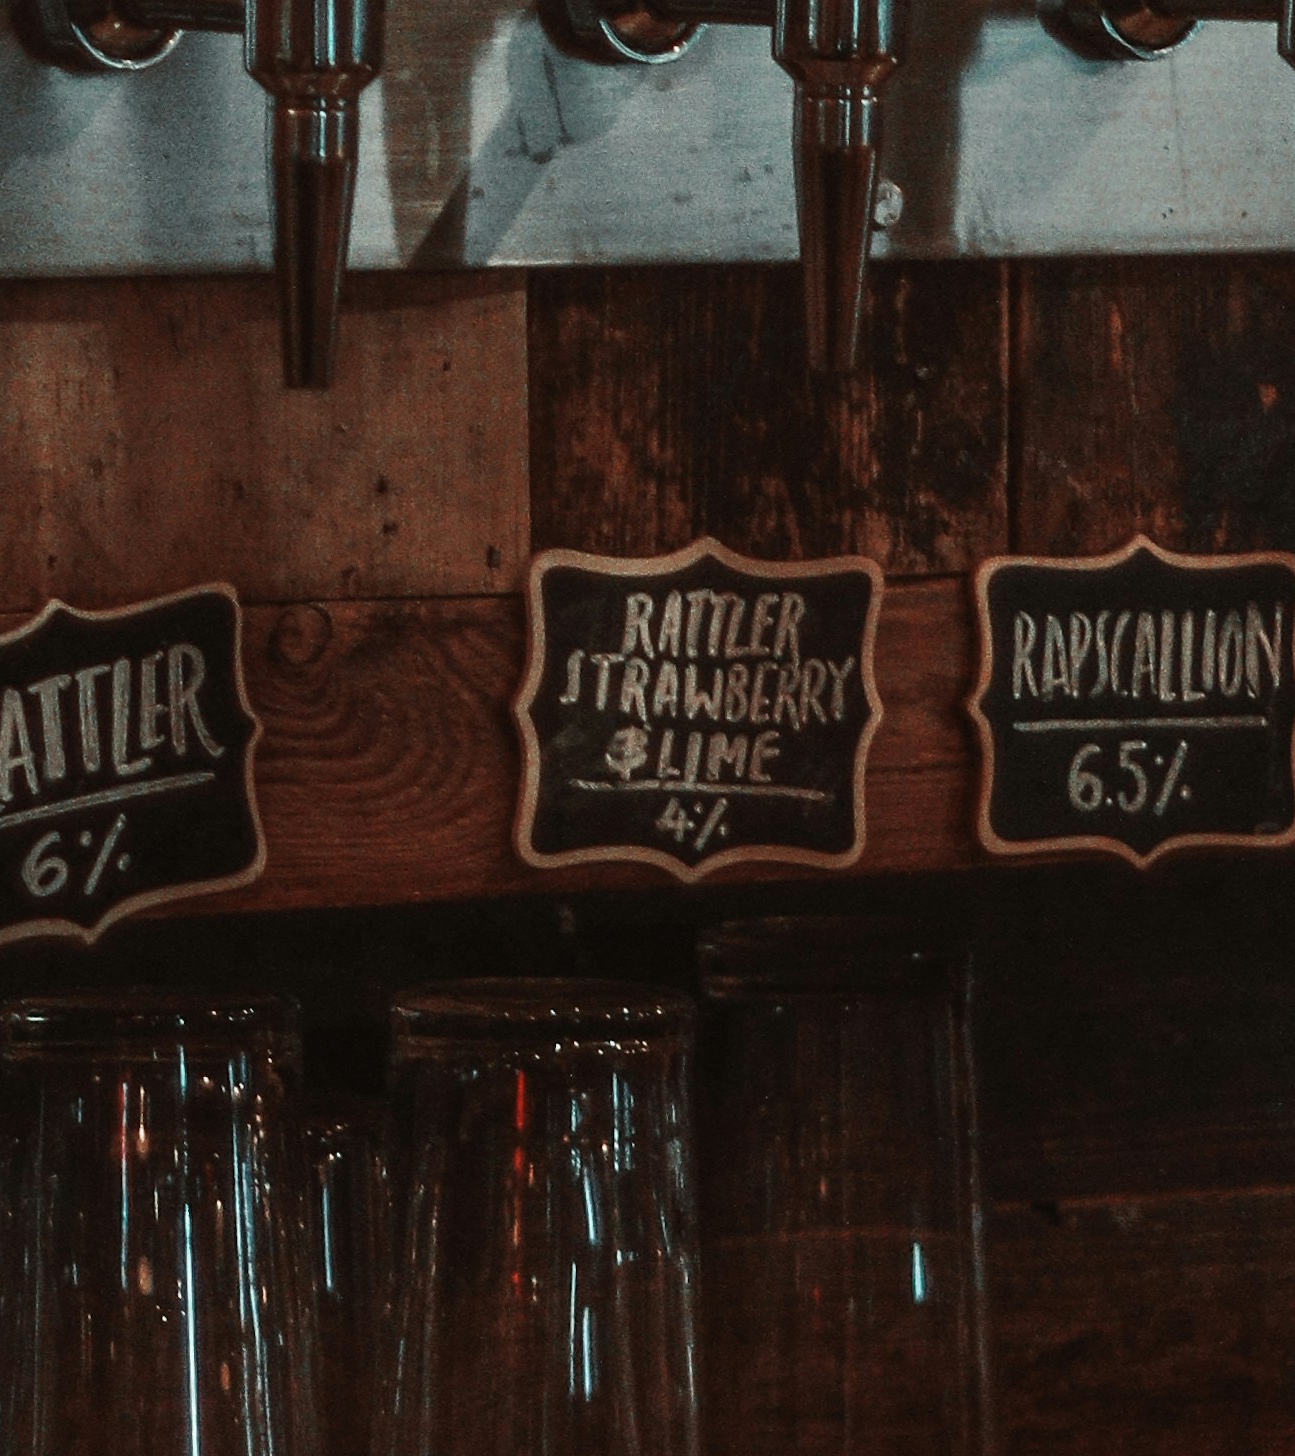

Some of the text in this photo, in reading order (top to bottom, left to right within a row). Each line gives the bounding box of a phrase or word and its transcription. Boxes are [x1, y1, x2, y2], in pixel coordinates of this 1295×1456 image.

[620, 588, 806, 661] RATTLER
[1011, 600, 1283, 702] RAPSCALLION
[558, 649, 855, 731] STRAWBERRY
[1067, 738, 1192, 817] 6.5%
[21, 813, 131, 898] 6%
